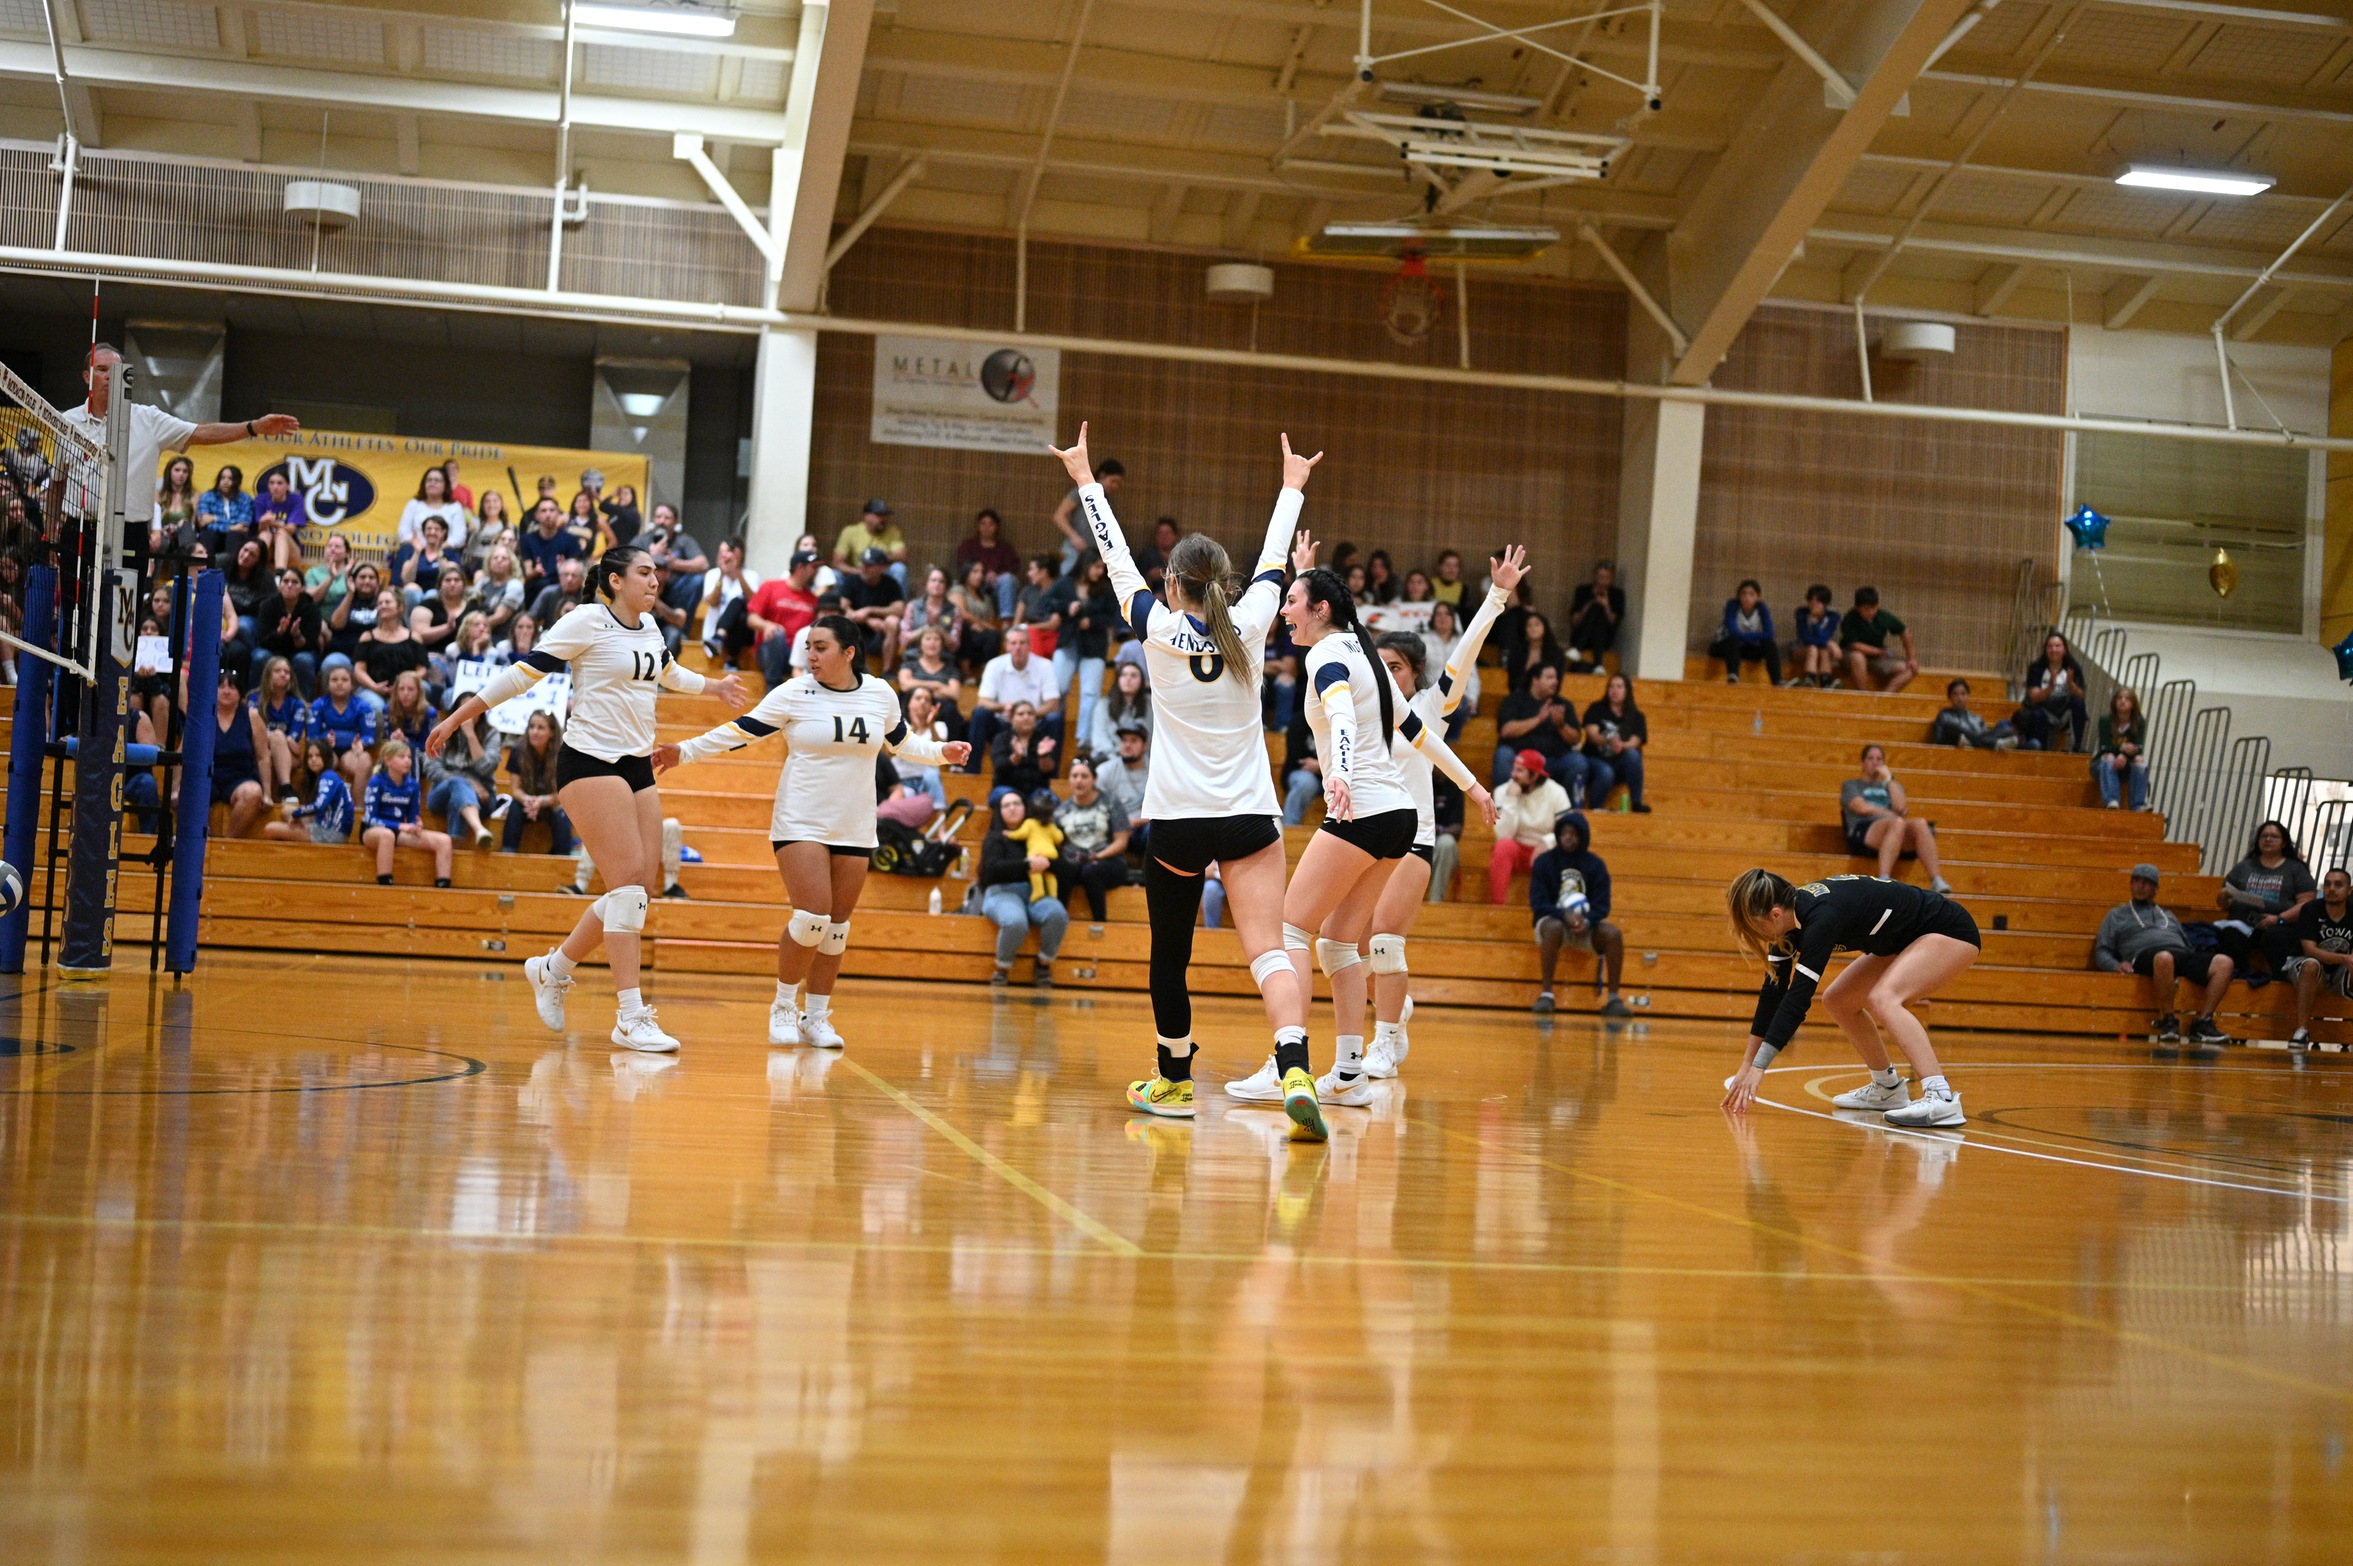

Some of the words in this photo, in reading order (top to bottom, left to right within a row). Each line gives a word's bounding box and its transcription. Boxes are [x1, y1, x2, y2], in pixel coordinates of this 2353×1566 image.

[893, 355, 974, 378] METAL
[1085, 495, 1113, 551] EAGLES
[118, 586, 134, 651] MC
[632, 650, 656, 681] 12
[832, 715, 870, 744] 14
[1339, 729, 1351, 772] EAGLES
[102, 676, 128, 957] EAGLES
